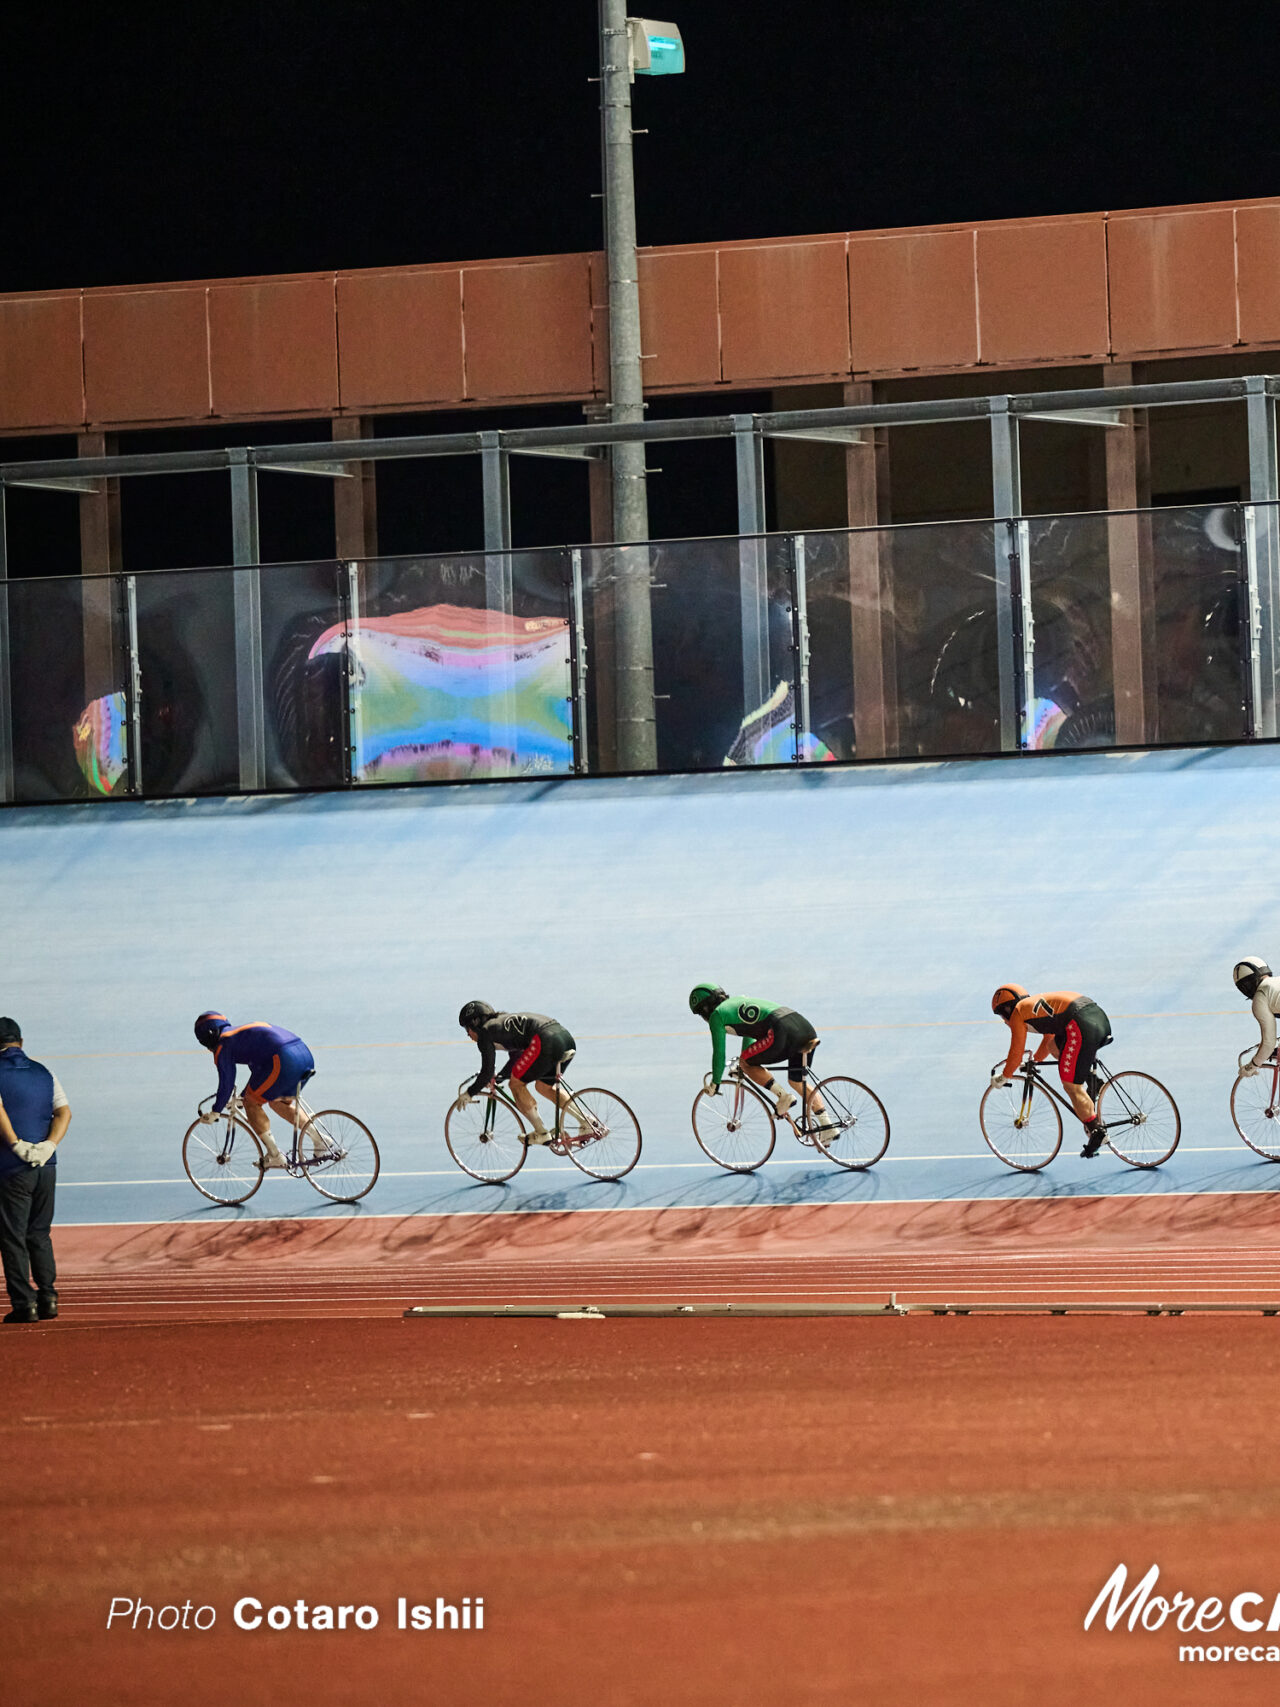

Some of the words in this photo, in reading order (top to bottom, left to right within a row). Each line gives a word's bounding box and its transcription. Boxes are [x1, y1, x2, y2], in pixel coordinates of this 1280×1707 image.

[738, 1002, 760, 1024] 6
[1032, 997, 1054, 1018] 7
[504, 1014, 527, 1035] 2
